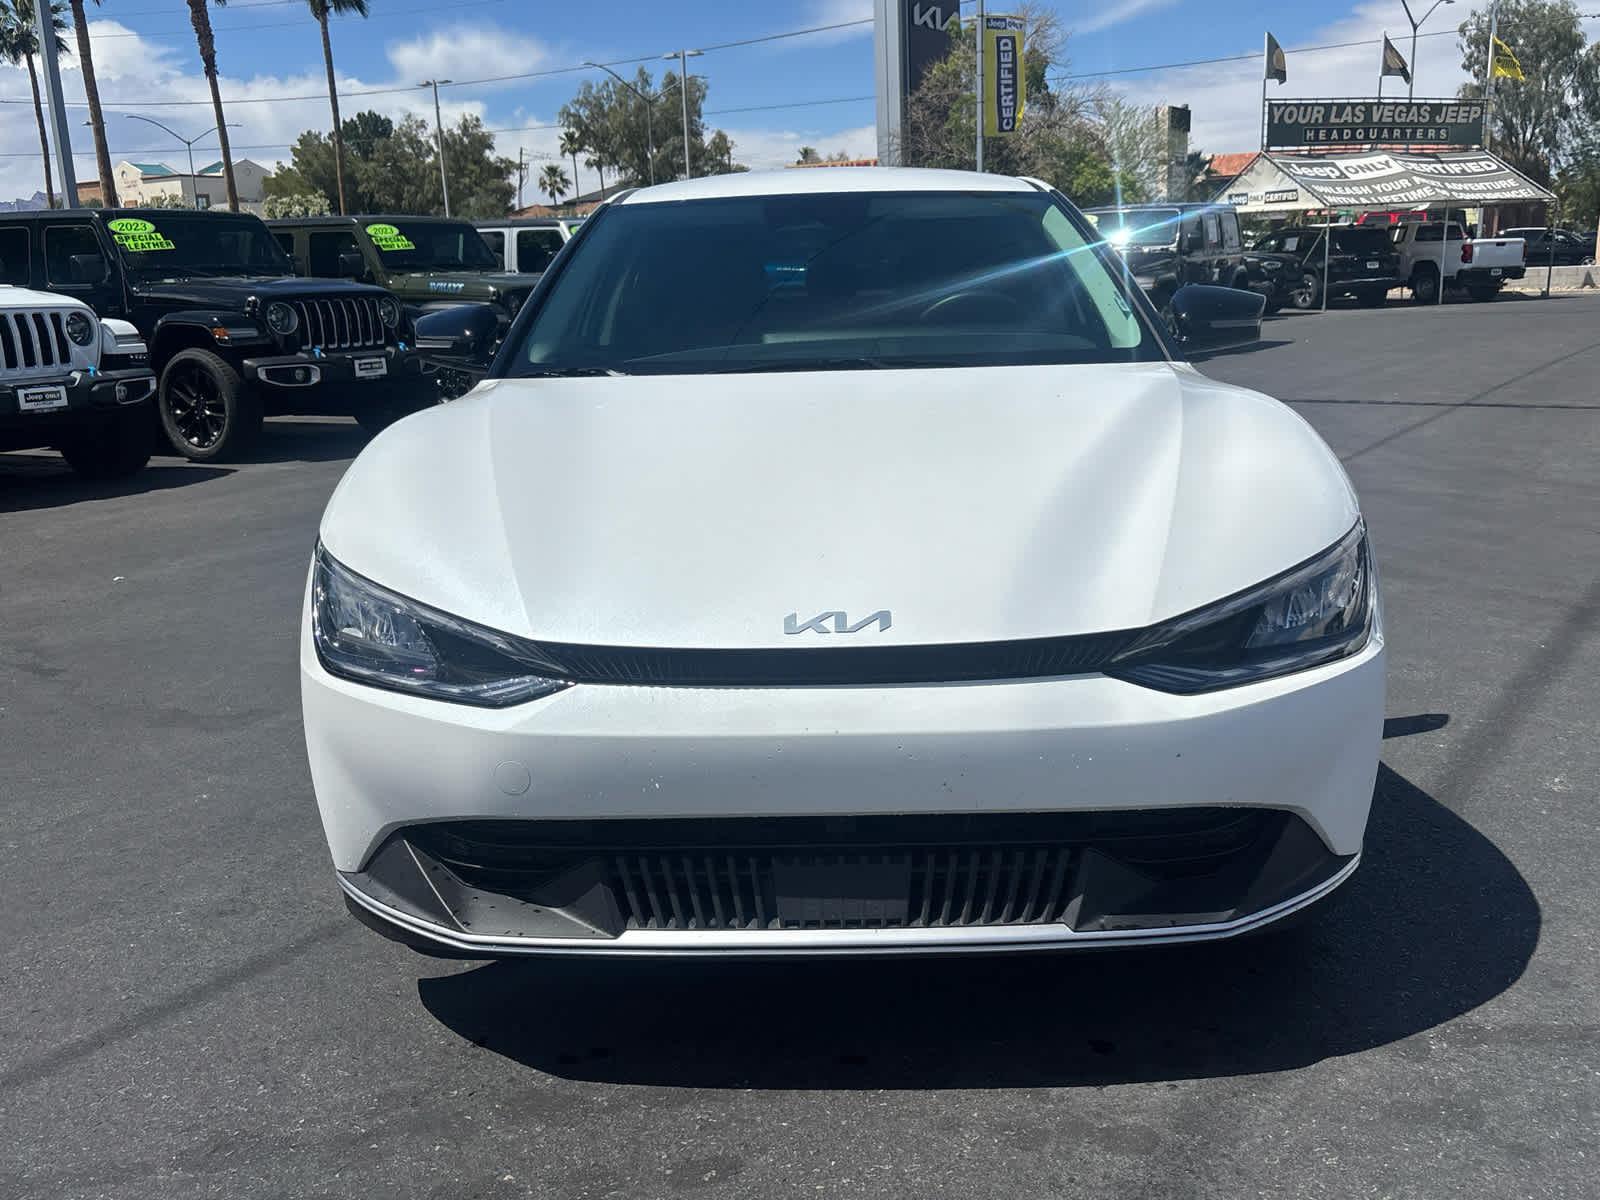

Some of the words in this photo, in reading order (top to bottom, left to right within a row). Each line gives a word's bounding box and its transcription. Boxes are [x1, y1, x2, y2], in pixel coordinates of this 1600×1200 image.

[1000, 38, 1014, 131] CERTIFIED
[1272, 105, 1325, 124] YOUR
[1329, 105, 1366, 123] LAS
[1372, 105, 1431, 123] VEGAS
[1436, 106, 1481, 123] JEEP
[1306, 128, 1447, 140] HEADQUARTERS
[1290, 164, 1341, 179] Jeep
[1344, 160, 1393, 175] ONLY
[1371, 179, 1412, 193] YOUR
[1444, 178, 1520, 190] ADVENTURE
[1265, 191, 1298, 202] CERTIFIED
[1370, 186, 1436, 203] LIFETIME
[117, 222, 147, 231] 2023
[117, 234, 161, 243] SPECIAL
[128, 241, 173, 250] LEATHER
[784, 610, 892, 634] KIA
